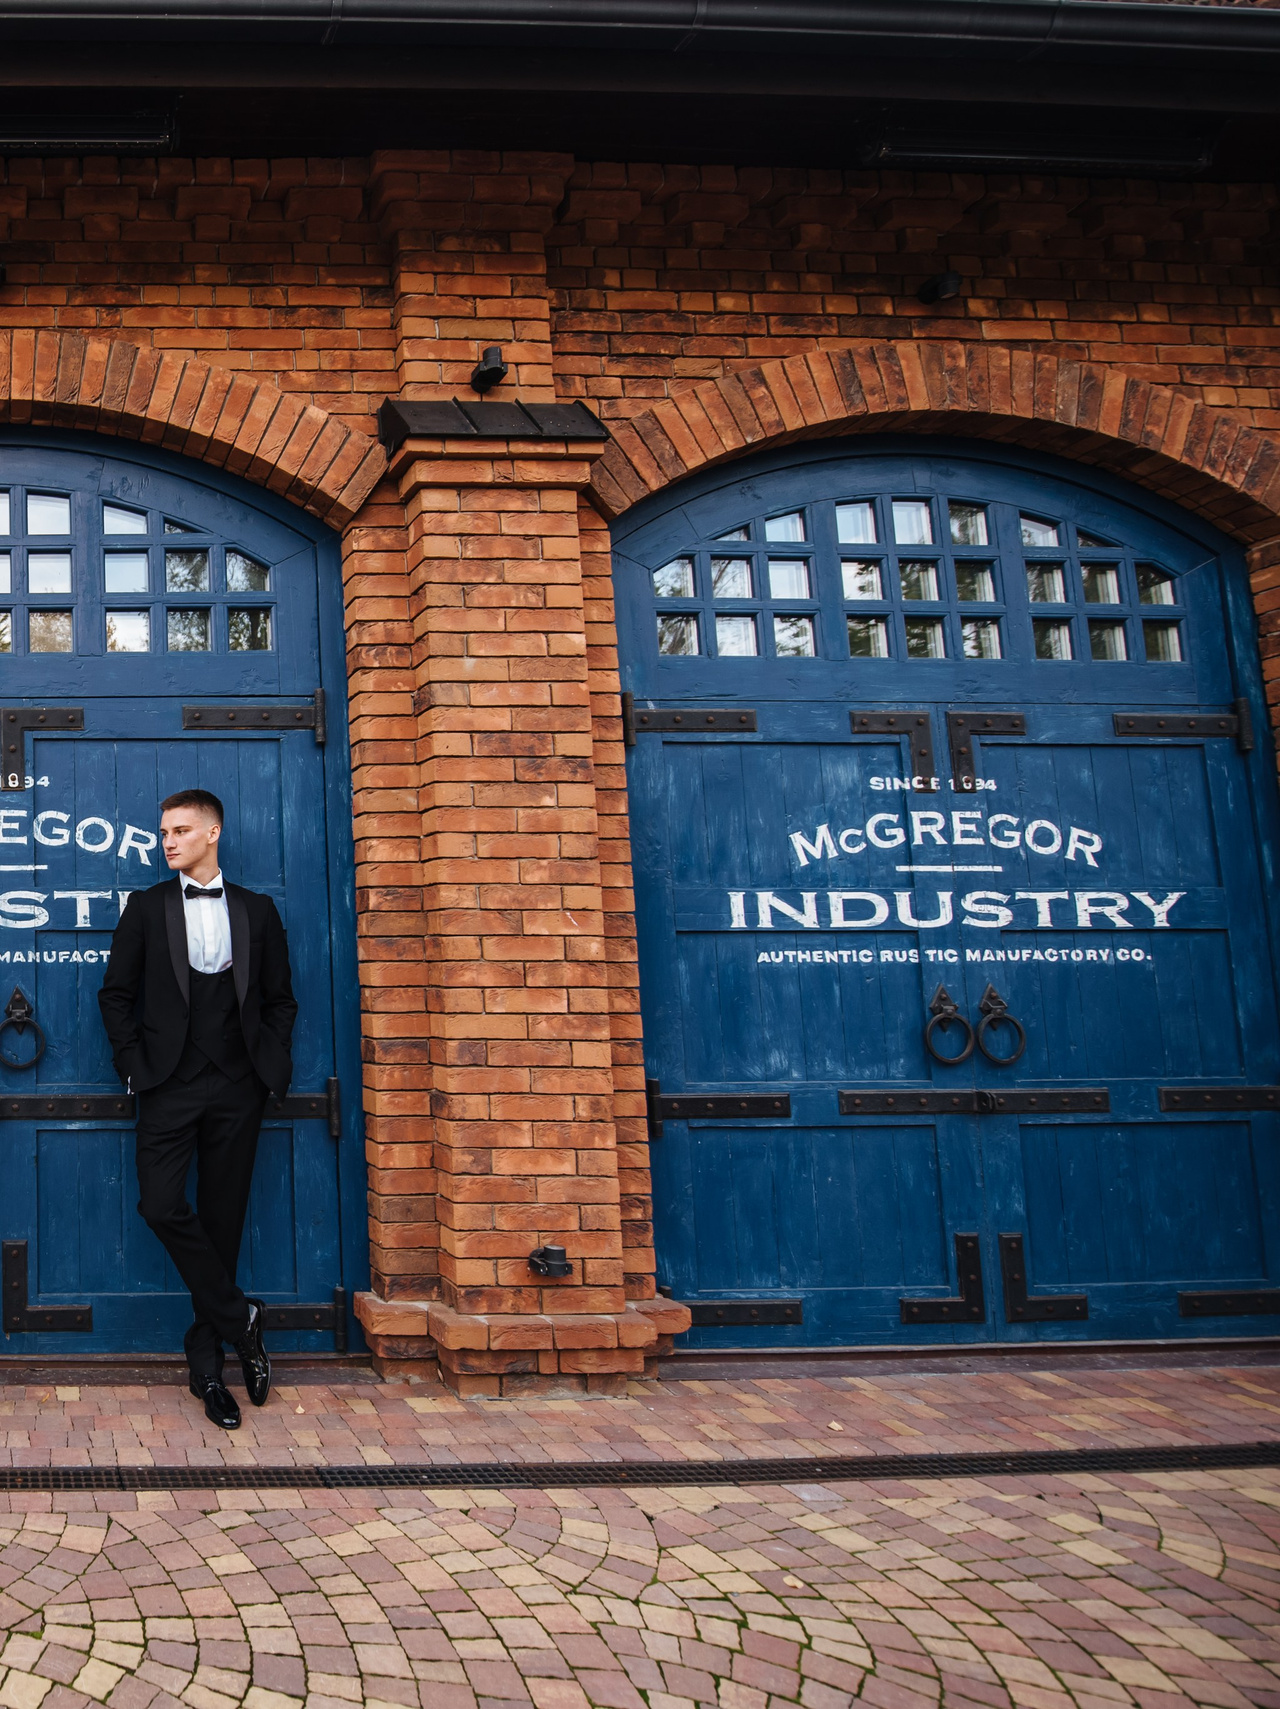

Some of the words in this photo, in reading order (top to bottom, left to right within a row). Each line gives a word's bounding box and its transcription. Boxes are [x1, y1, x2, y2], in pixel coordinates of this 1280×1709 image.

[869, 775, 941, 791] SINCE
[788, 810, 1103, 867] McGREGOR
[727, 890, 1188, 928] INDUSTRY
[757, 949, 873, 963] AUTHENTIC
[880, 949, 959, 963] RUSTIC
[965, 949, 1110, 962] MANUFACTORY
[1116, 949, 1153, 962] CO.
